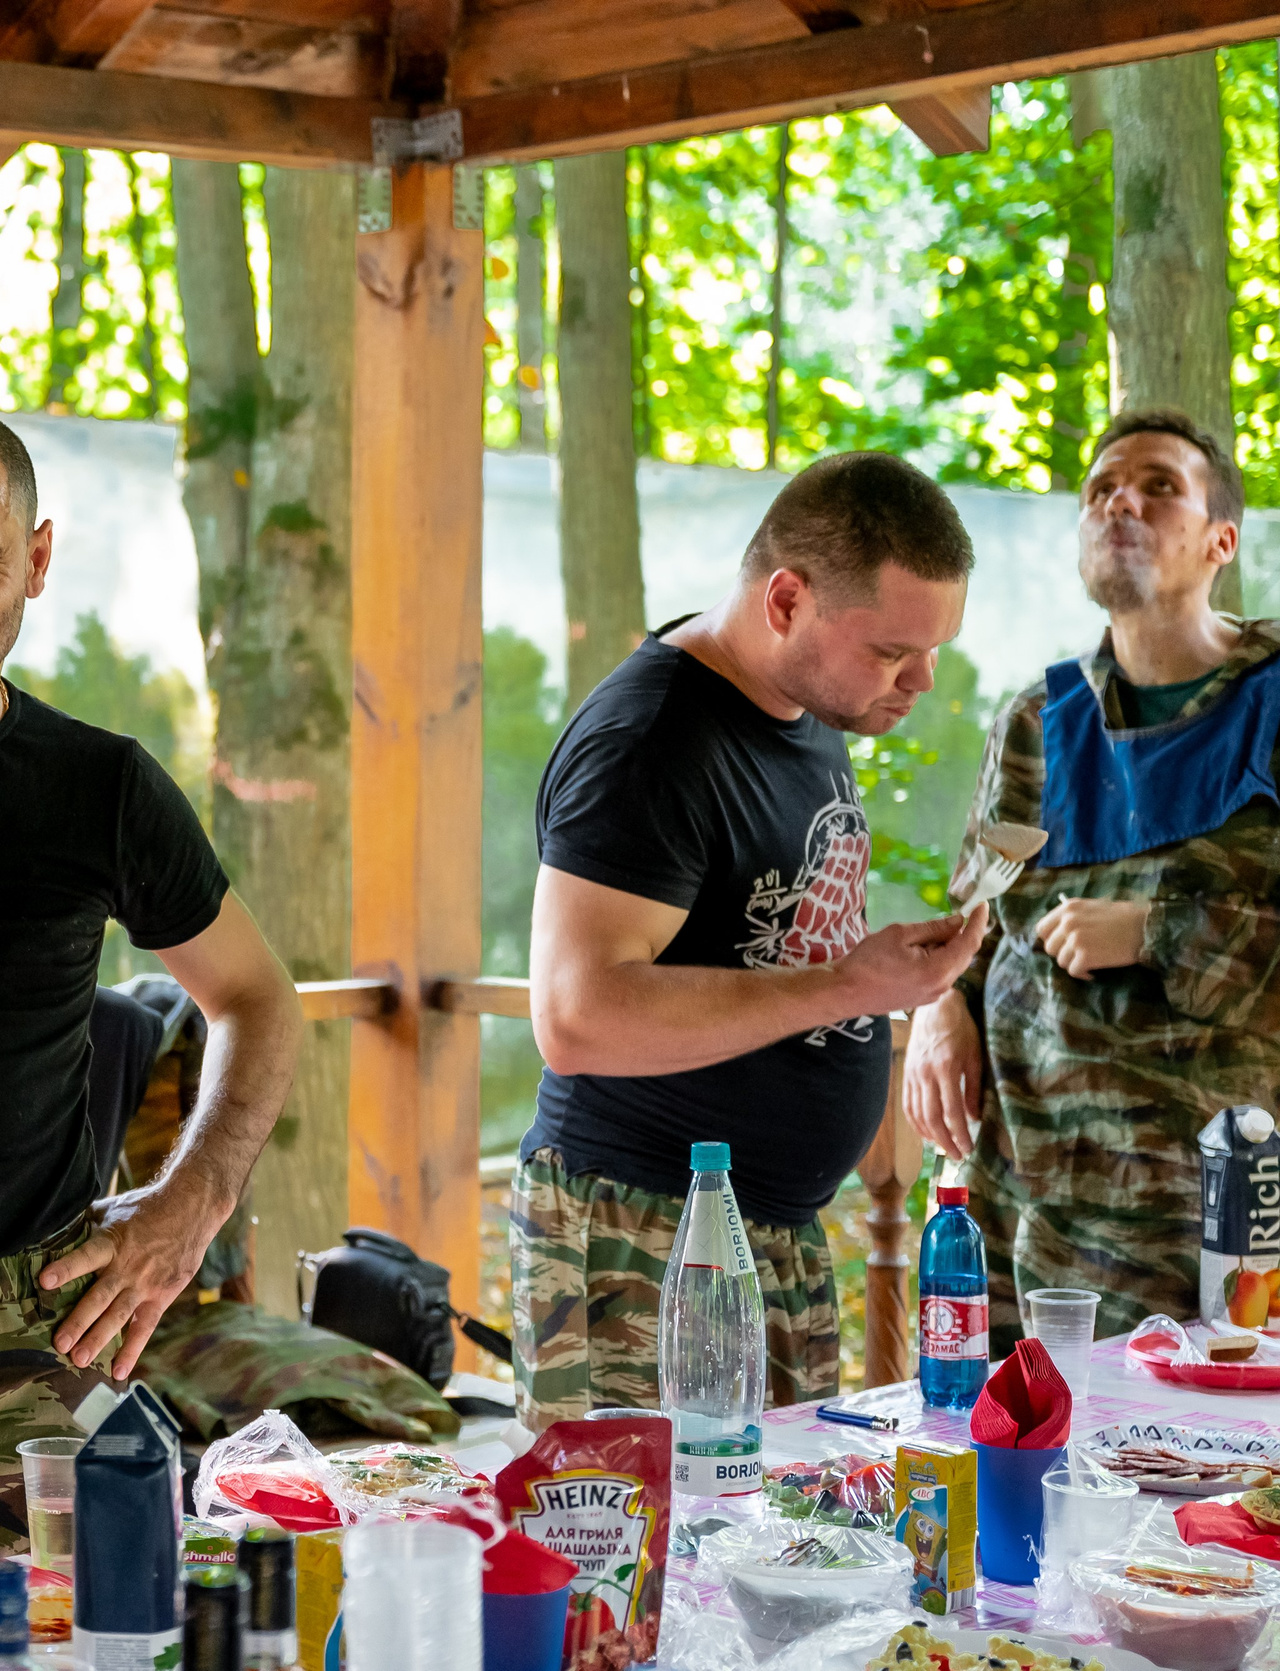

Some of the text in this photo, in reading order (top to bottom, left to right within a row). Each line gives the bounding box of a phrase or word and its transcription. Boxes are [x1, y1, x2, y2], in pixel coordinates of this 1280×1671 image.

[1248, 1155, 1280, 1252] Rich
[723, 1193, 749, 1270] BORJOMI
[545, 1484, 623, 1511] HEINZ
[545, 1526, 623, 1541] ДЛЯ ГРИЛЯ
